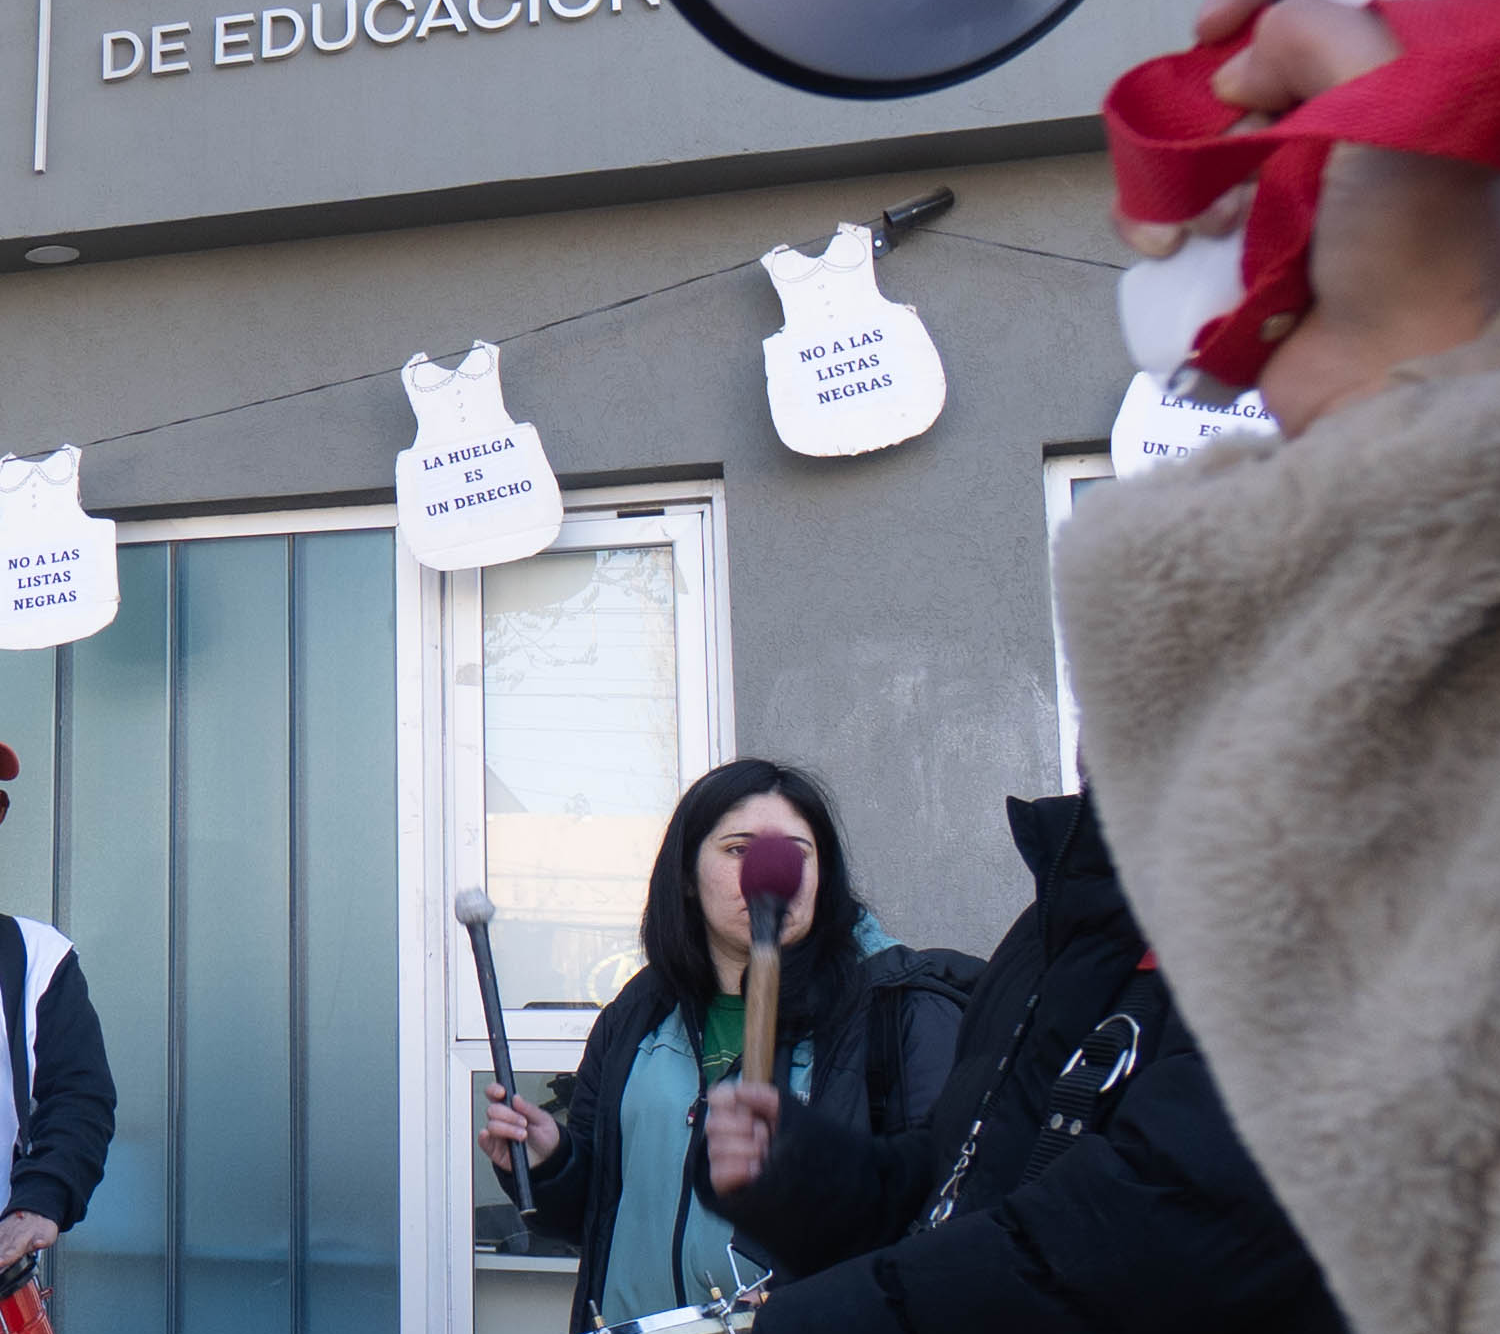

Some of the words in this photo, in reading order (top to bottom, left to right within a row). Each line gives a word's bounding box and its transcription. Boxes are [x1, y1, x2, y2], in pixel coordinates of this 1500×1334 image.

[103, 21, 192, 82] DE
[799, 346, 825, 362] NO
[833, 341, 845, 353] A
[848, 329, 883, 348] LAS
[816, 354, 880, 381] LISTAS
[817, 374, 893, 404] NEGRAS
[423, 457, 444, 471] LA
[448, 437, 515, 464] HUELGA
[1142, 441, 1169, 457] UN
[464, 469, 483, 483] ES
[426, 501, 449, 516] UN
[454, 480, 532, 510] DERECHO
[8, 557, 30, 570] NO
[36, 555, 46, 566] A
[51, 548, 80, 563] LAS
[17, 570, 71, 589] LISTAS
[13, 590, 77, 611] NEGRAS
